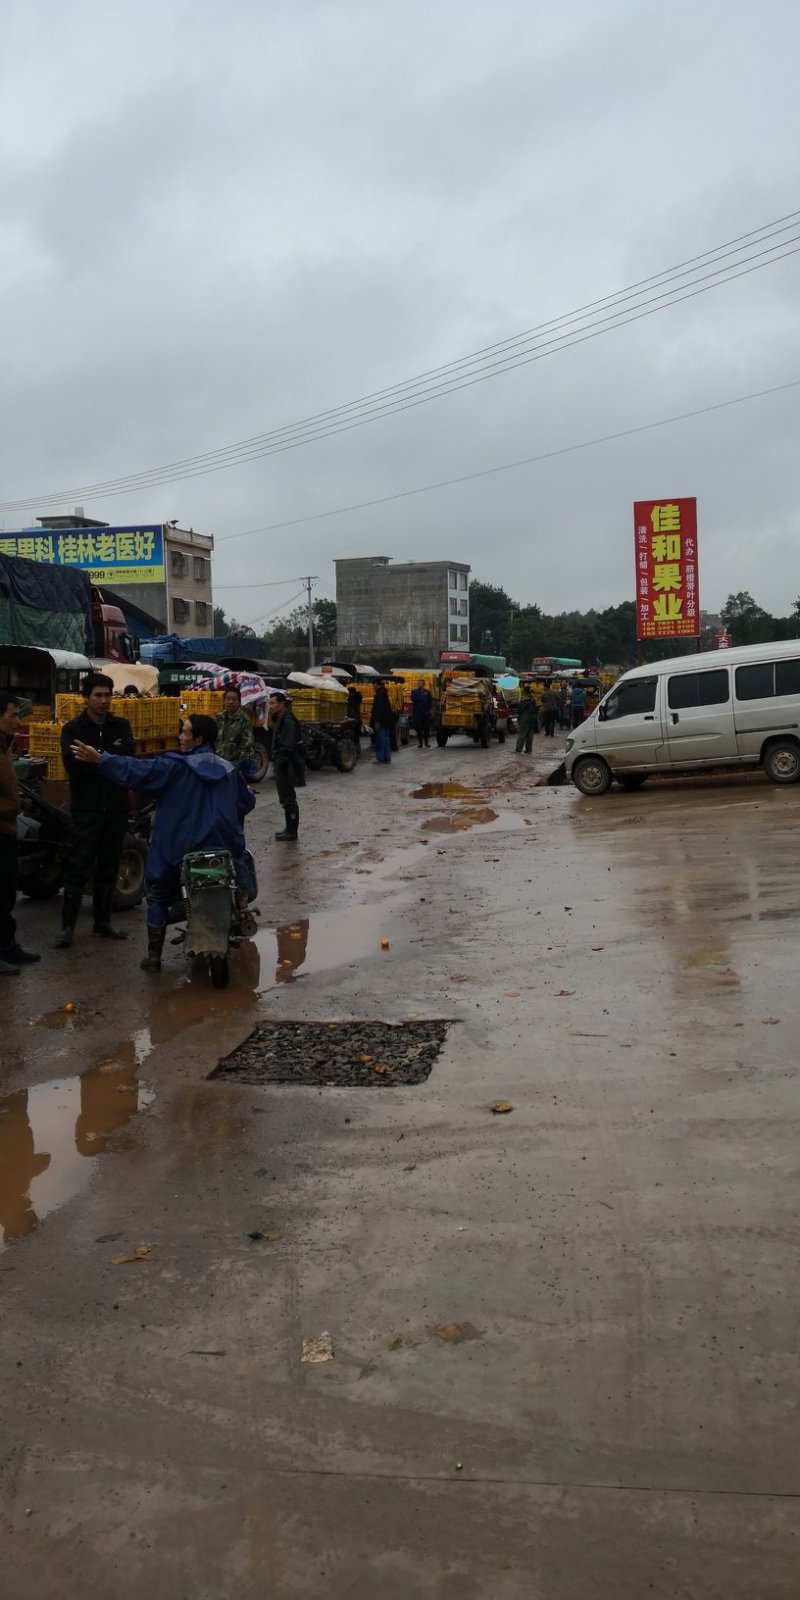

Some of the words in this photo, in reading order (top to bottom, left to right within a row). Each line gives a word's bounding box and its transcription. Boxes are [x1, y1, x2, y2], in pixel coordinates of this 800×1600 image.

[58, 532, 155, 564] 桂林老医好
[650, 504, 683, 621] 佳和果业
